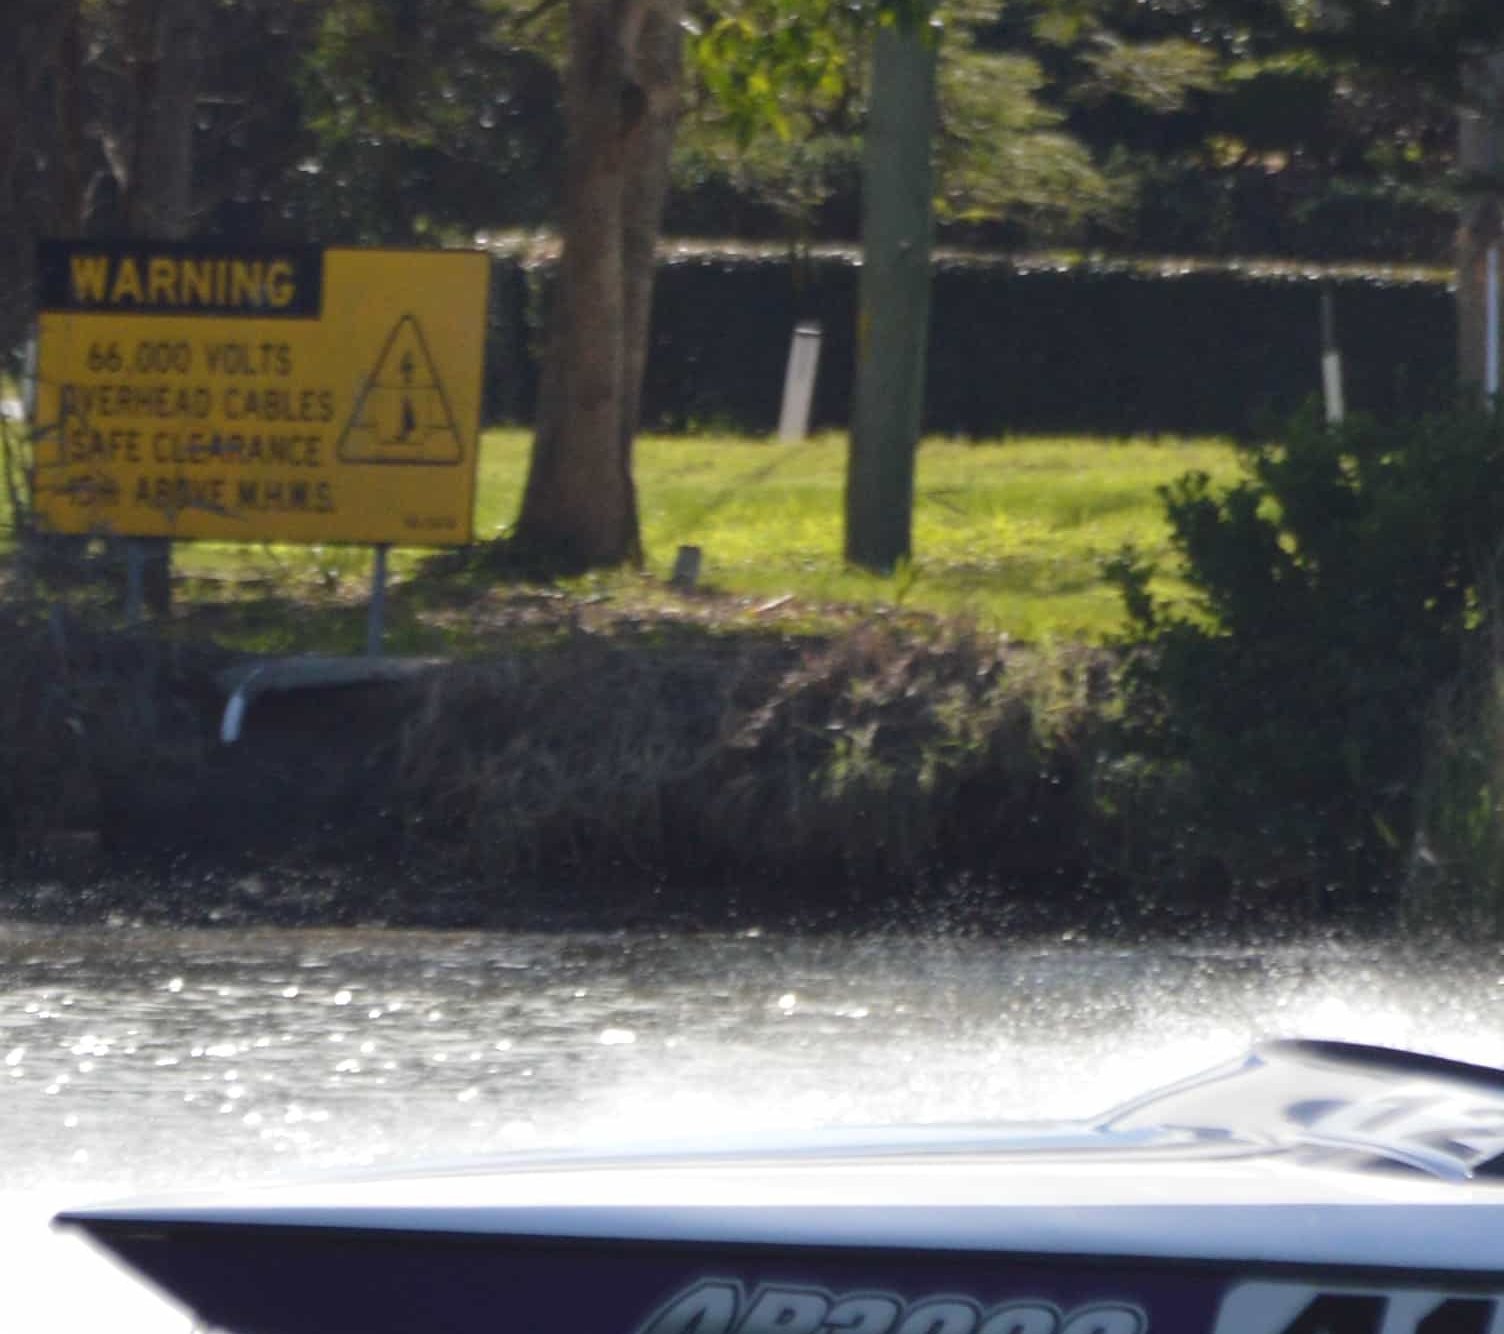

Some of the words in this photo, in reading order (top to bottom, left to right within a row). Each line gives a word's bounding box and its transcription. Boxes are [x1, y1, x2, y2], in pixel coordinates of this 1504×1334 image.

[70, 256, 296, 307] WARNING
[204, 341, 293, 377] VOLTS
[223, 387, 335, 423] CABLES
[69, 427, 142, 463] SAFE
[152, 430, 324, 467] CLEARANCE
[135, 475, 226, 509] ABOVE
